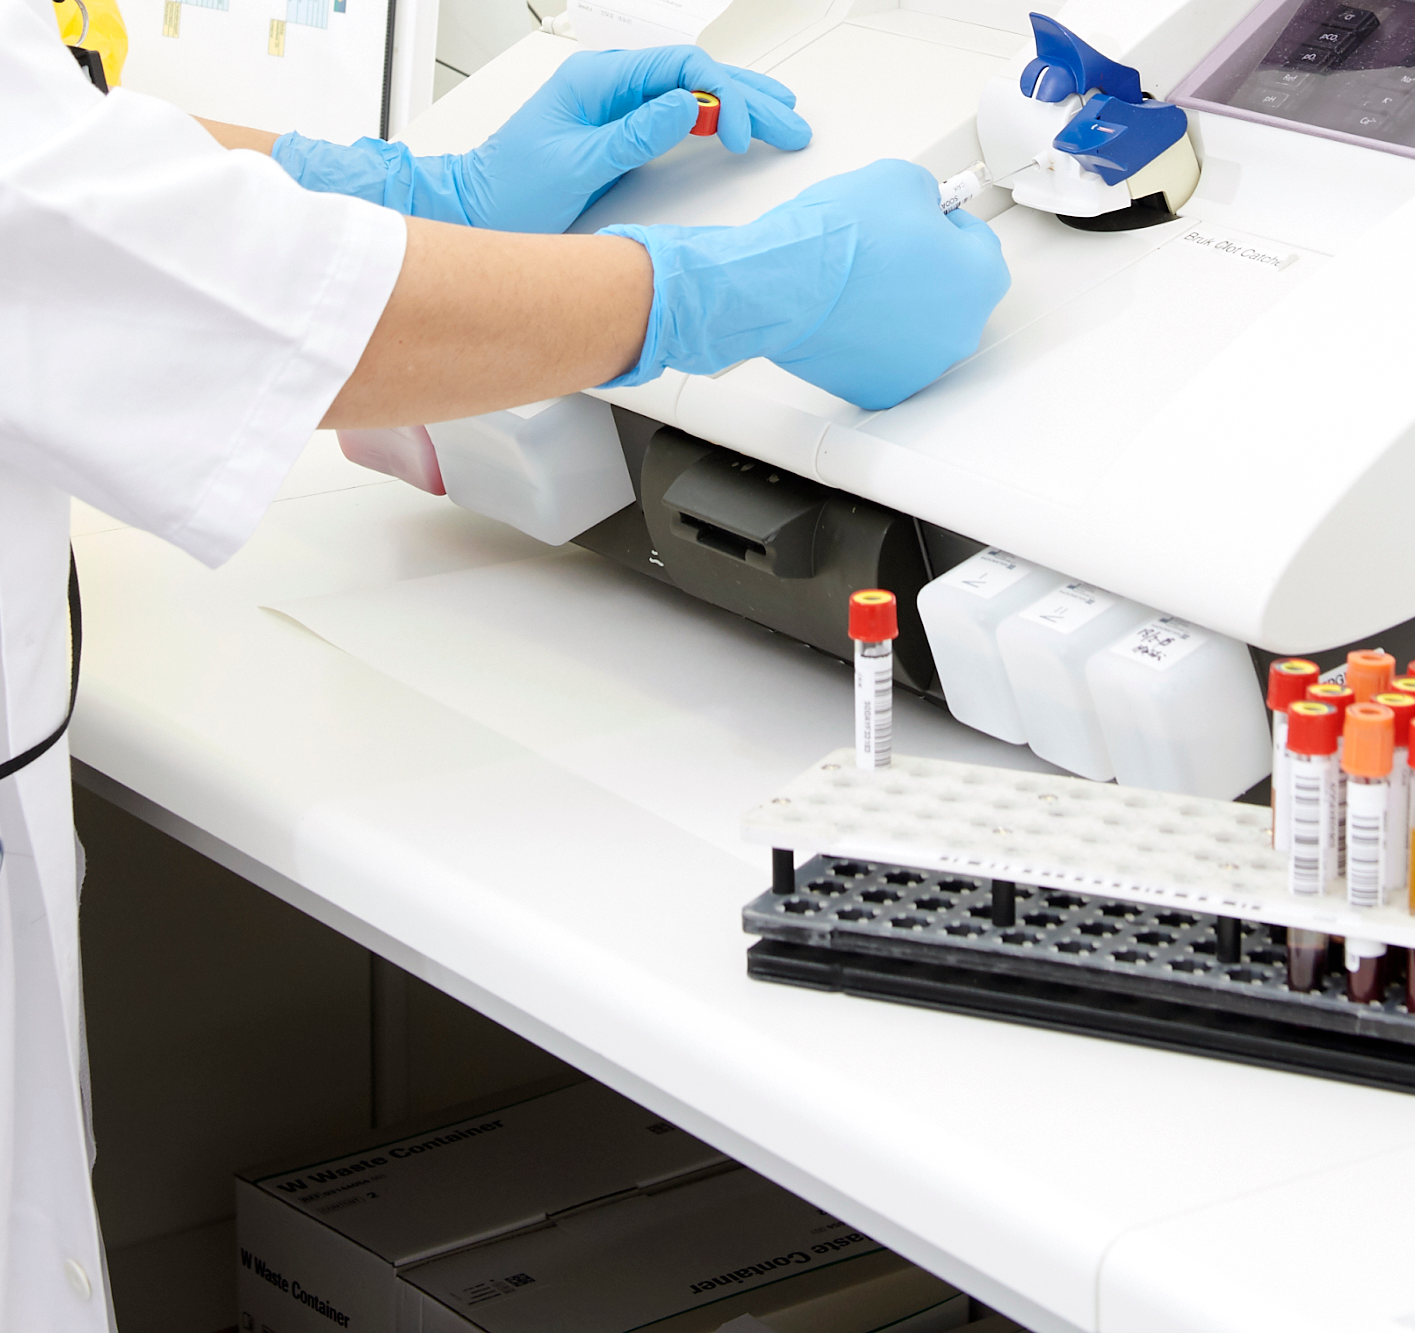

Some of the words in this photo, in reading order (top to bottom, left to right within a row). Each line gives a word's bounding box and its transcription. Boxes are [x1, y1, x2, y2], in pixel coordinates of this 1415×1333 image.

[1183, 231, 1215, 246] Bruk
[1214, 240, 1243, 254] Clot
[277, 1178, 307, 1193] W
[306, 1157, 388, 1184] Waste
[388, 1119, 504, 1159] Container
[810, 1233, 873, 1255] aste
[241, 1247, 252, 1269] W
[254, 1256, 289, 1293] Waste
[292, 1280, 350, 1328] Container
[689, 1251, 812, 1294] Container
